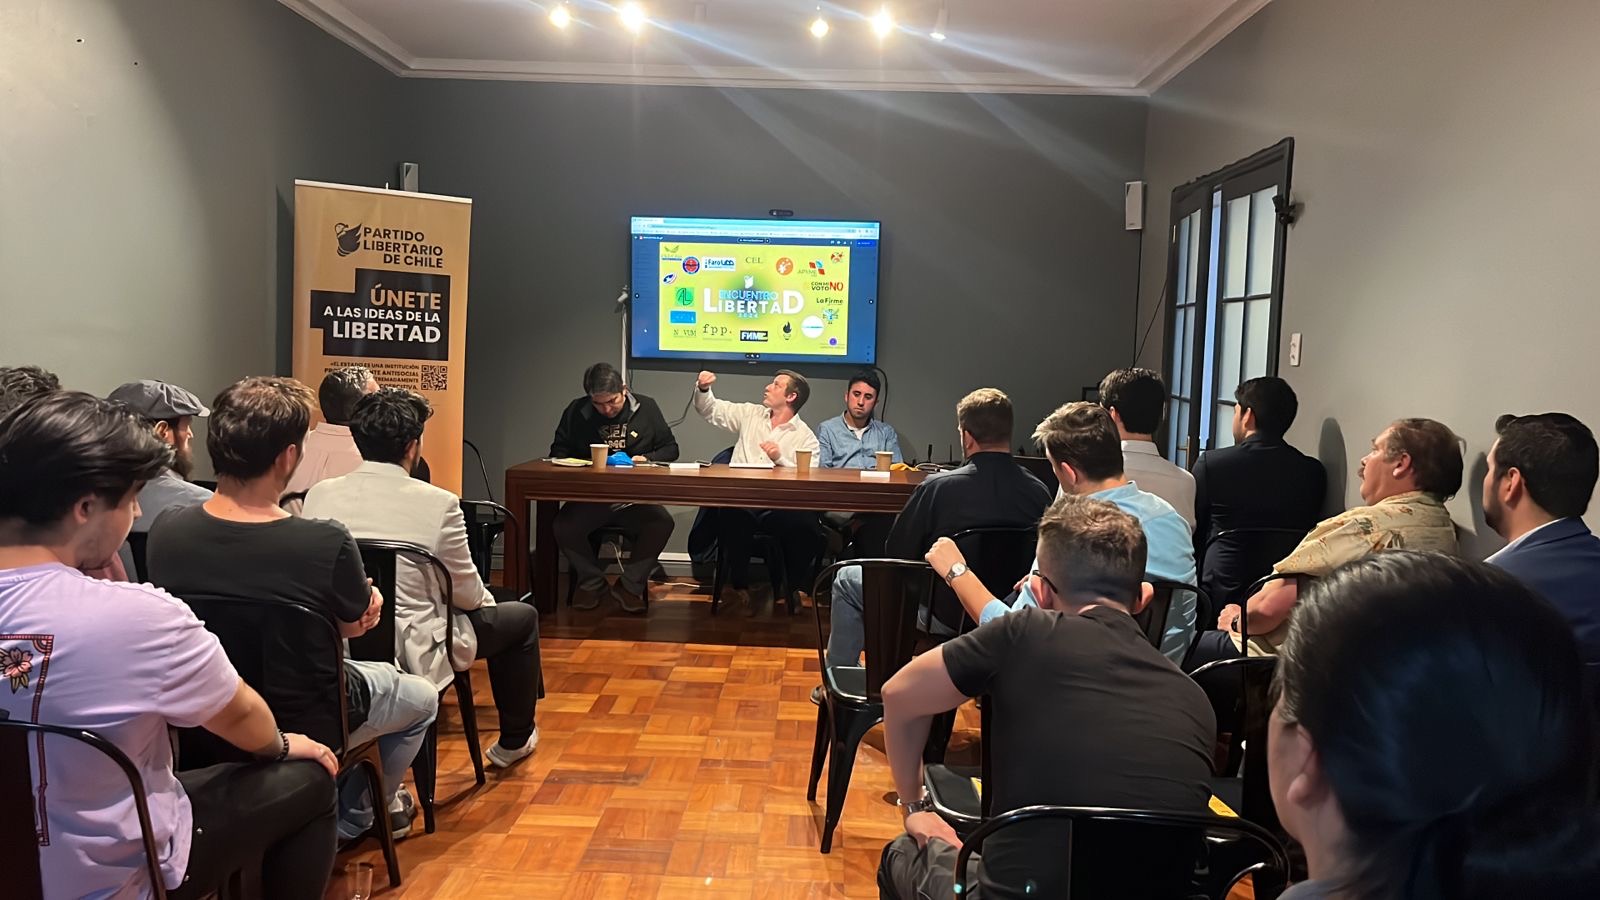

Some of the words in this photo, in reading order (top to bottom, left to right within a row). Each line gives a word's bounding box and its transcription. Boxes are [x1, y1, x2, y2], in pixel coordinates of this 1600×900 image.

[364, 226, 424, 242] PARTIDO
[364, 240, 443, 256] LIBERTARIO
[384, 254, 400, 265] DE
[404, 255, 443, 268] CHILE
[830, 282, 844, 292] NO
[370, 283, 442, 310] ÚNETE
[324, 306, 334, 316] A
[337, 306, 361, 318] LAS
[364, 308, 403, 321] IDEAS
[406, 311, 422, 322] DE
[424, 312, 440, 324] LA
[332, 320, 441, 344] LIBERTAD
